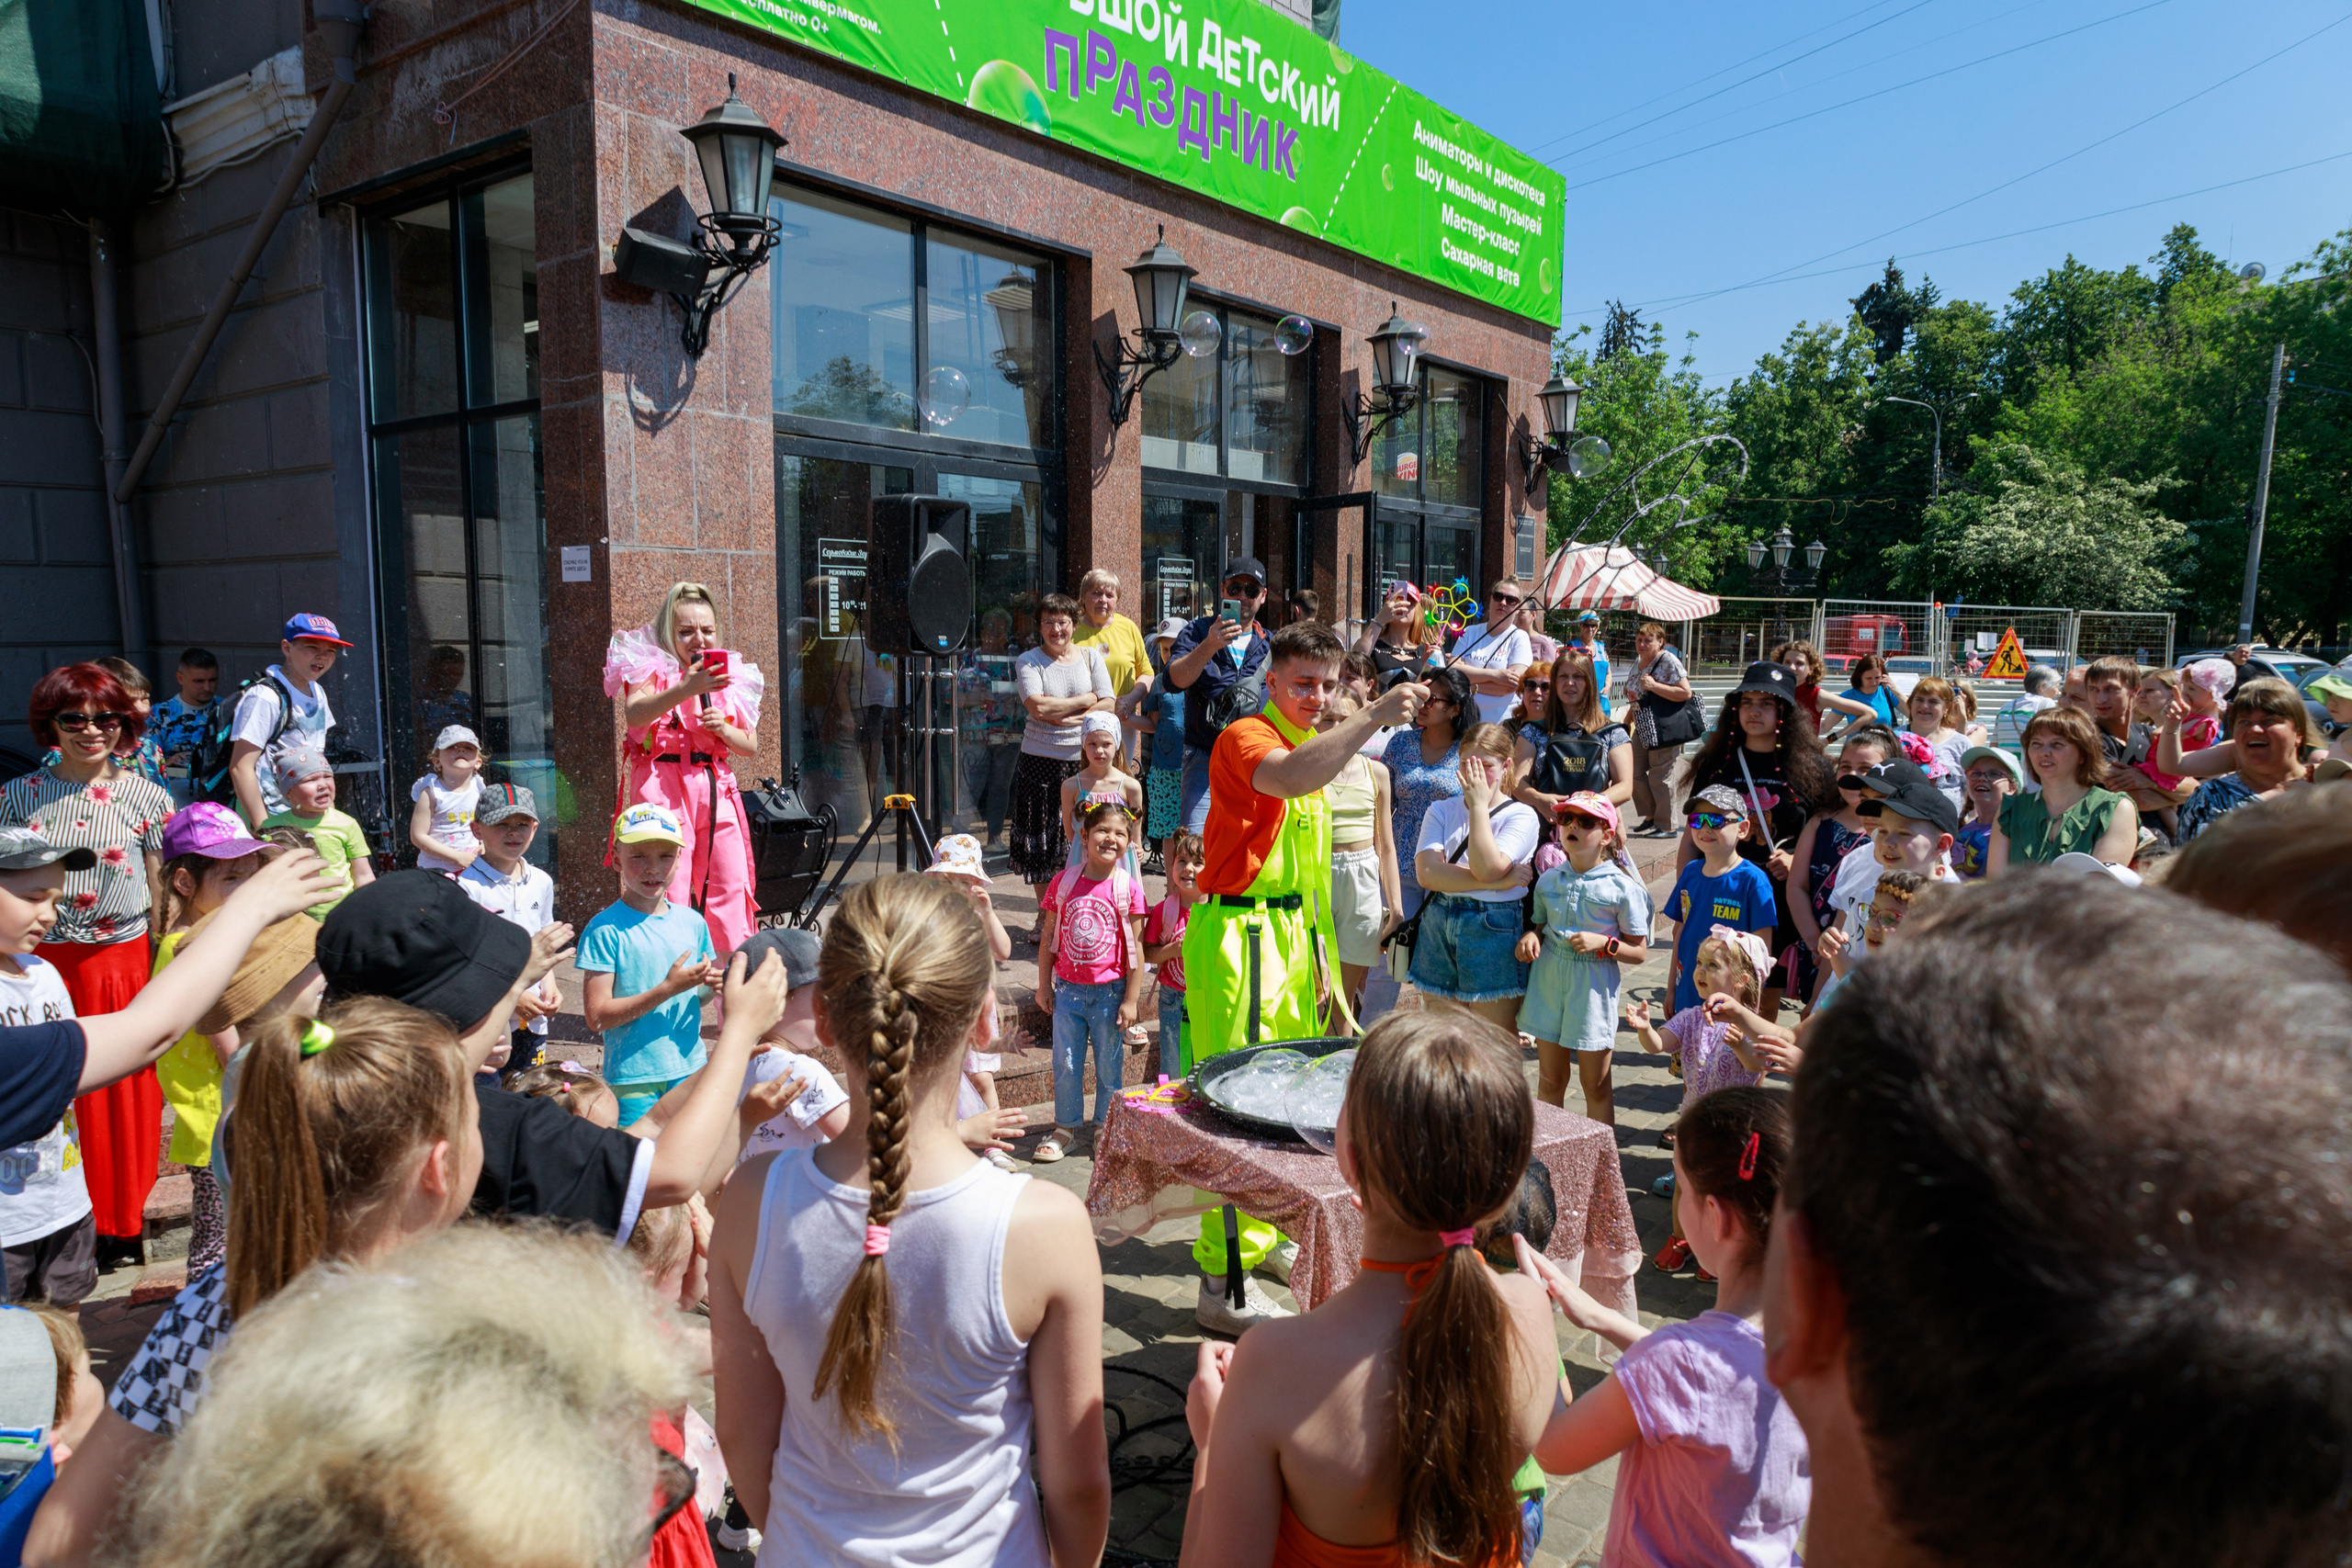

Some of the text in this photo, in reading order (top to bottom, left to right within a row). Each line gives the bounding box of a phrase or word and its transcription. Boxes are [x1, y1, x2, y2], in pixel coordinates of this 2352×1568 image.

[787, 0, 881, 35] ивермагом.
[1198, 17, 1340, 131] ДЕТСКИЙ
[1045, 26, 1299, 183] ПРАЗДНИК
[1413, 119, 1545, 208] Аниматоры и дискотека
[1416, 155, 1542, 236] Шоу мыльных пузырей
[1442, 203, 1521, 256] Мастер-класс
[1442, 237, 1520, 288] Сахарная вата
[1563, 756, 1586, 764] 2018
[1065, 900, 1084, 923] ANGELS
[1093, 902, 1114, 928] PIRATES
[1713, 897, 1741, 908] PATROL
[1713, 904, 1741, 921] TEAM
